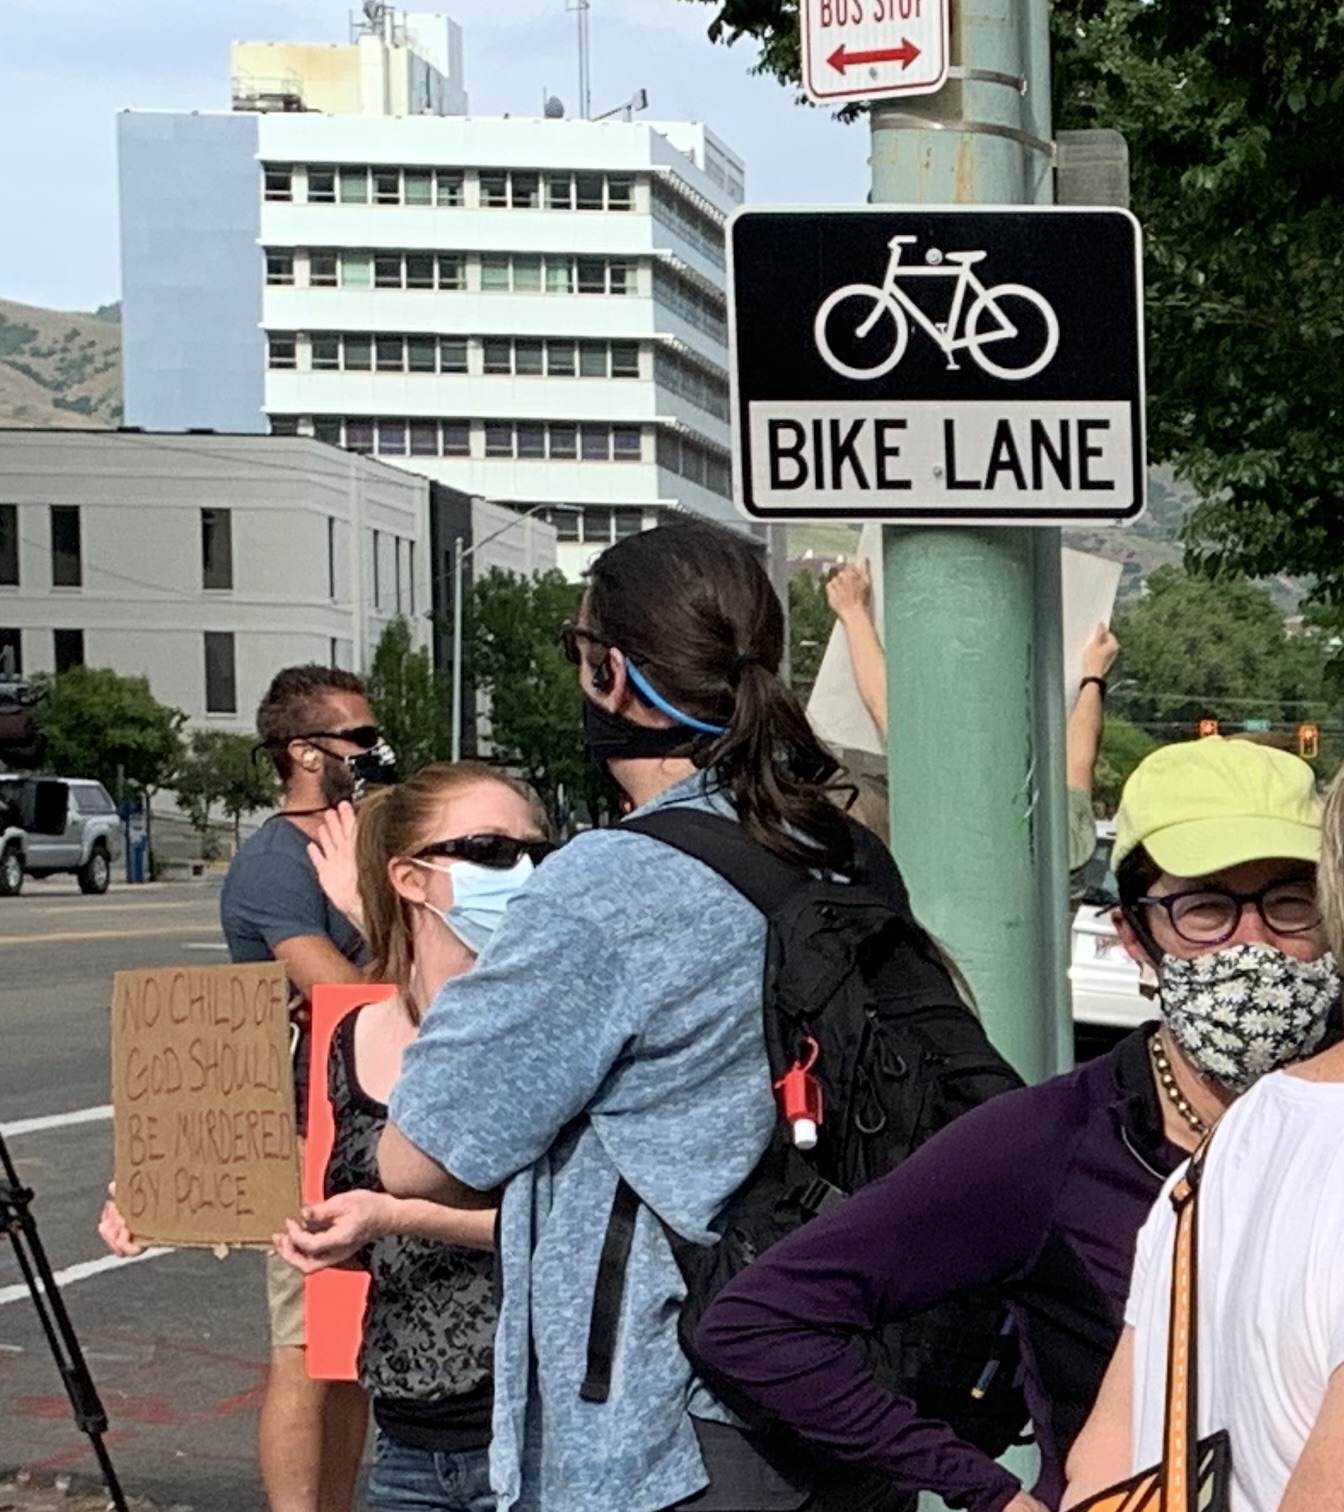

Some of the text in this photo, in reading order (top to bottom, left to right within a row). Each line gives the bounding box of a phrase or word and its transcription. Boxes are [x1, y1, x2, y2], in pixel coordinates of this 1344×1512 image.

[821, 0, 863, 28] BUS
[768, 418, 1115, 491] BIKE LANE
[121, 972, 283, 1033] NO CHILD OF
[124, 1038, 283, 1101] GOD SHOULD
[128, 1108, 293, 1166] BE MURDERED
[128, 1166, 254, 1220] BY POLICE
